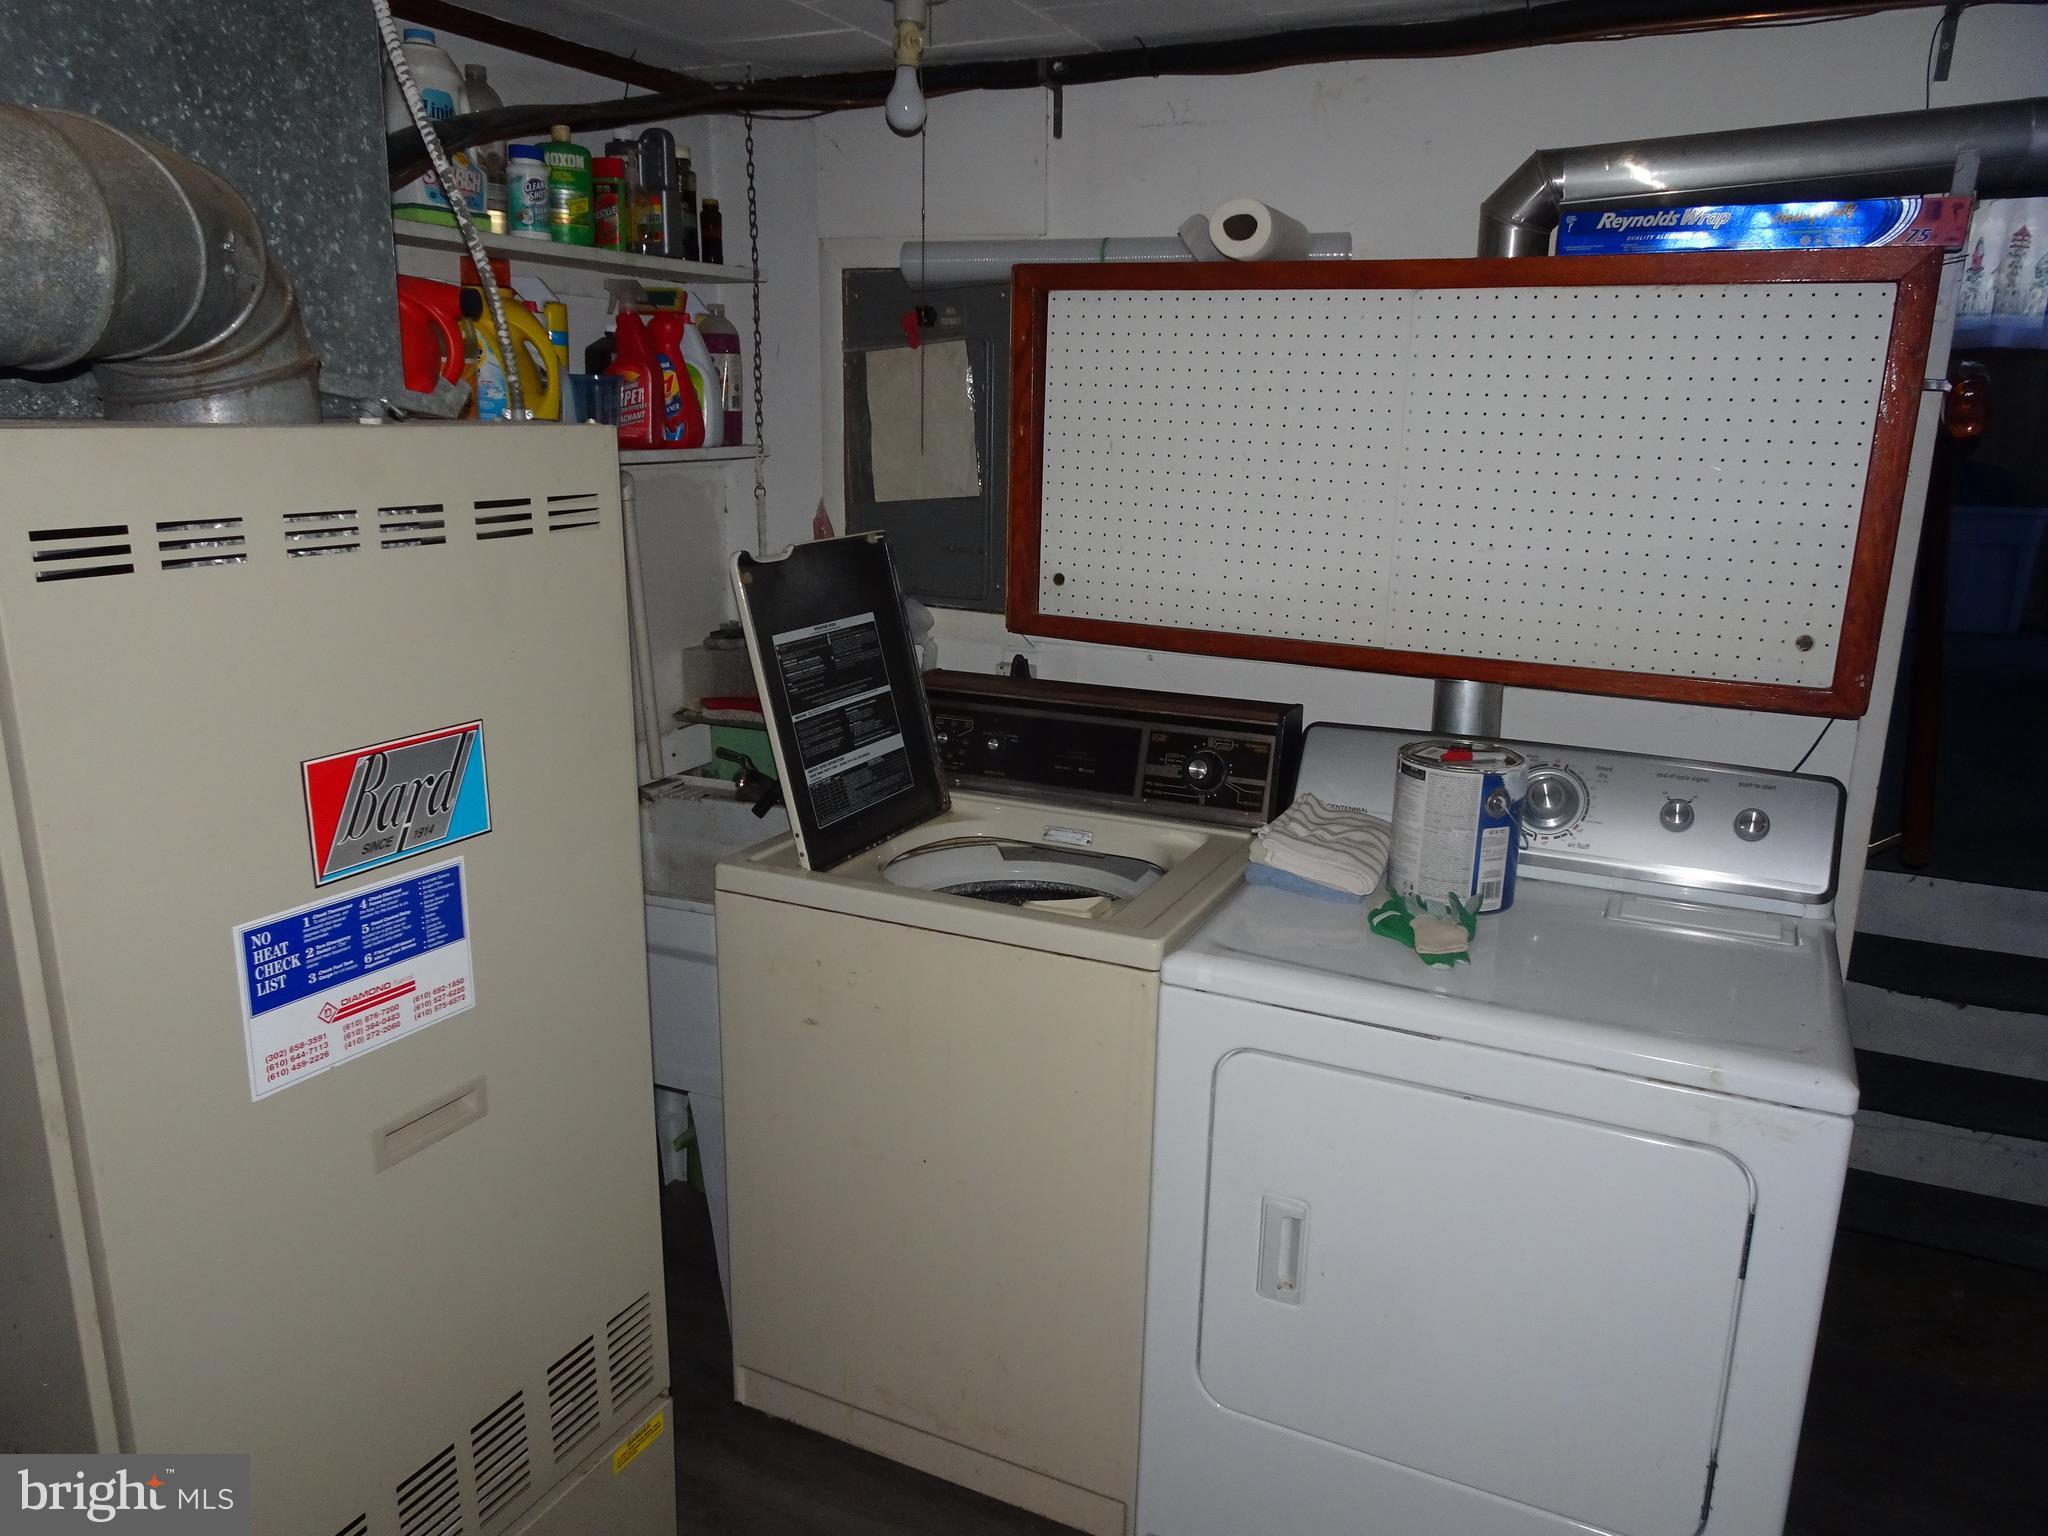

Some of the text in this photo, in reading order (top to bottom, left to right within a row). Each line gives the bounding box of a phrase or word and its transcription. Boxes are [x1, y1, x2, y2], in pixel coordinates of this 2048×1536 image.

[1596, 208, 1732, 232] Reynolds Wrap
[1903, 228, 1932, 243] 75
[337, 732, 467, 846] Bard
[361, 824, 435, 856] SINCE 1914
[360, 899, 368, 910] 4
[303, 917, 310, 928] 1
[361, 924, 370, 934] 5
[251, 931, 272, 949] NO
[253, 941, 289, 965] HEAT
[305, 947, 315, 959] 2
[364, 953, 373, 964] 6
[255, 953, 301, 980] CHECK
[256, 974, 287, 997] LIST
[307, 972, 317, 984] 3
[341, 981, 392, 1006] DIAMOND
[412, 990, 431, 1004] (610)
[413, 999, 432, 1012] (610)
[414, 1007, 433, 1021] (410)
[343, 1018, 363, 1033] (610)
[344, 1026, 364, 1041] (610)
[344, 1035, 365, 1050] (410)
[265, 1048, 287, 1064] (302)
[266, 1041, 329, 1073] (610) 644-7113
[267, 1067, 289, 1083] (610)
